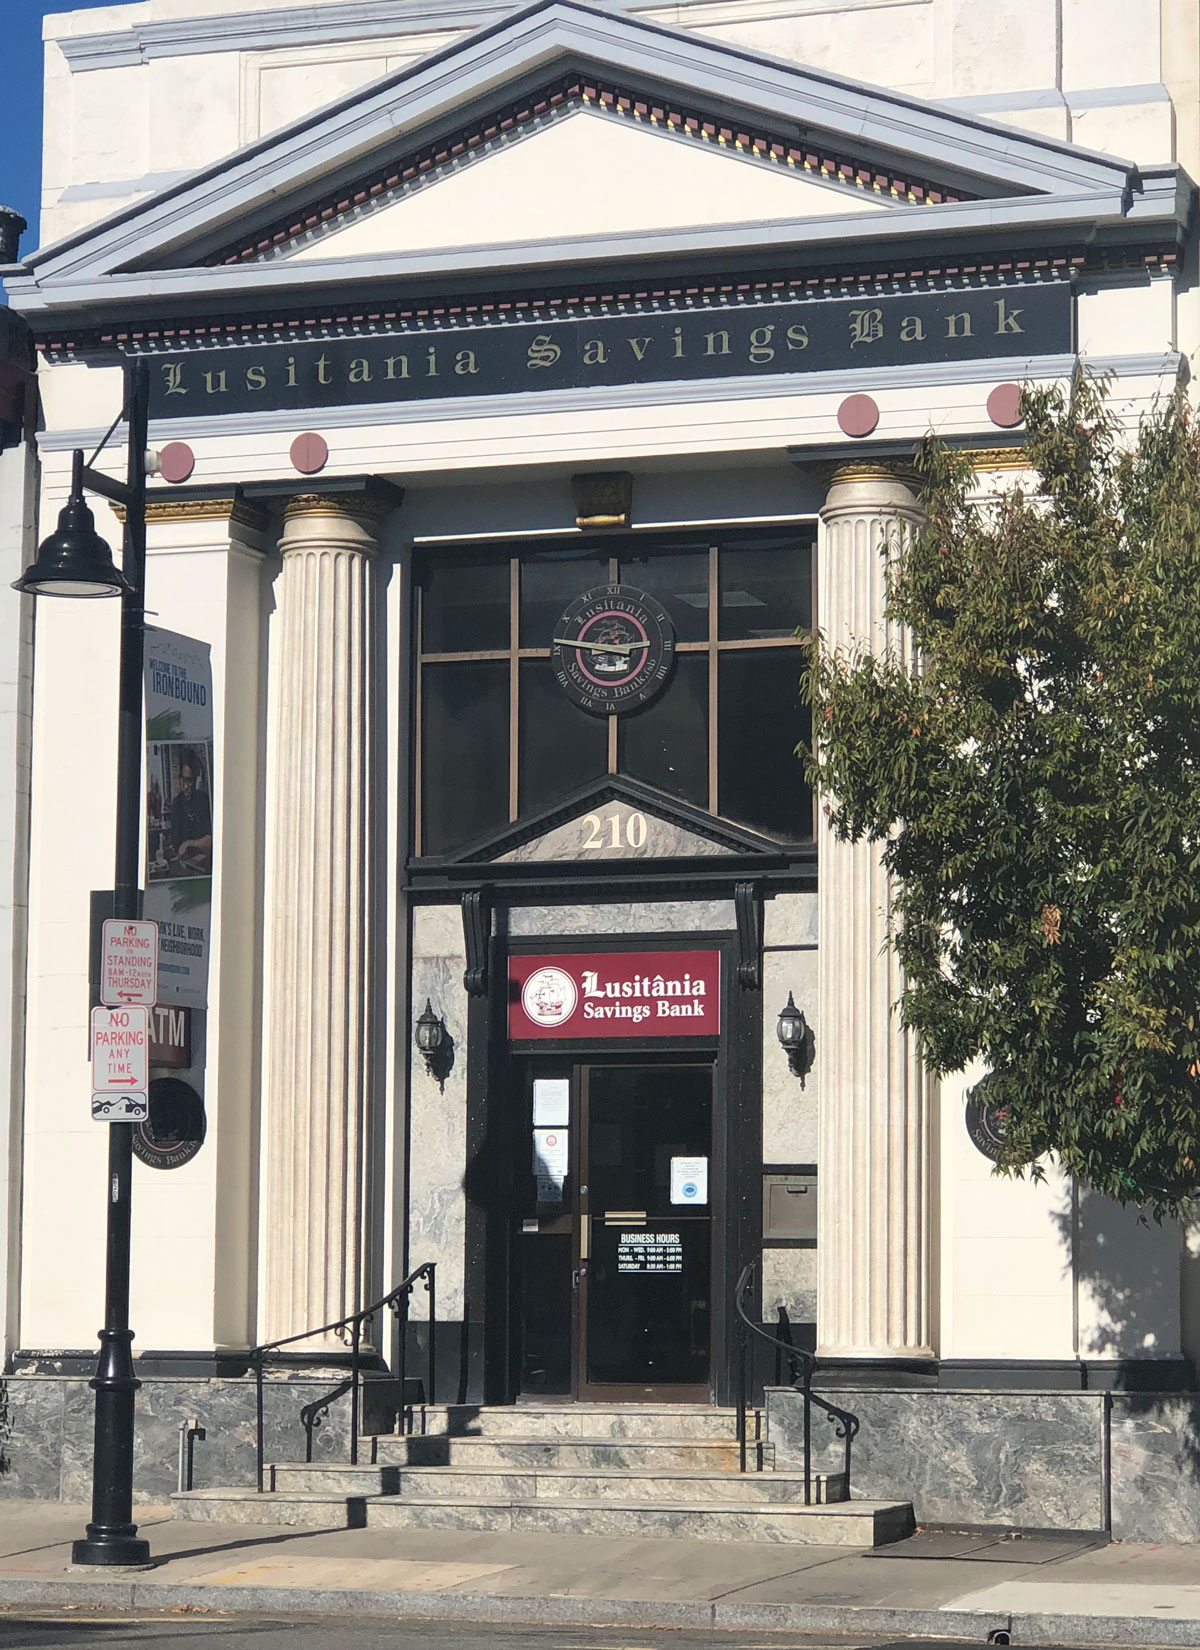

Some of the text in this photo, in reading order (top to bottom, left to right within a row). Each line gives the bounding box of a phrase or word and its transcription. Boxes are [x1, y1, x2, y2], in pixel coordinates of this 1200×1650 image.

[161, 299, 1026, 396] Lusitania Savings Bank
[607, 587, 620, 595] XII
[575, 600, 648, 625] Lusitania
[567, 662, 608, 698] Savings
[153, 670, 206, 706] IRONBOUND
[582, 813, 648, 849] 210
[124, 926, 137, 936] NO
[110, 937, 150, 949] PARKING
[108, 955, 152, 968] STANDING
[108, 977, 152, 989] THURSDAY
[581, 971, 706, 998] Lusitânia
[583, 1000, 705, 1022] Savings Bank
[110, 1012, 130, 1027] NO
[96, 1031, 144, 1046] PARKING
[109, 1049, 130, 1059] ANY
[108, 1063, 132, 1074] TIME
[621, 1233, 680, 1243] BUSINESS HOURS
